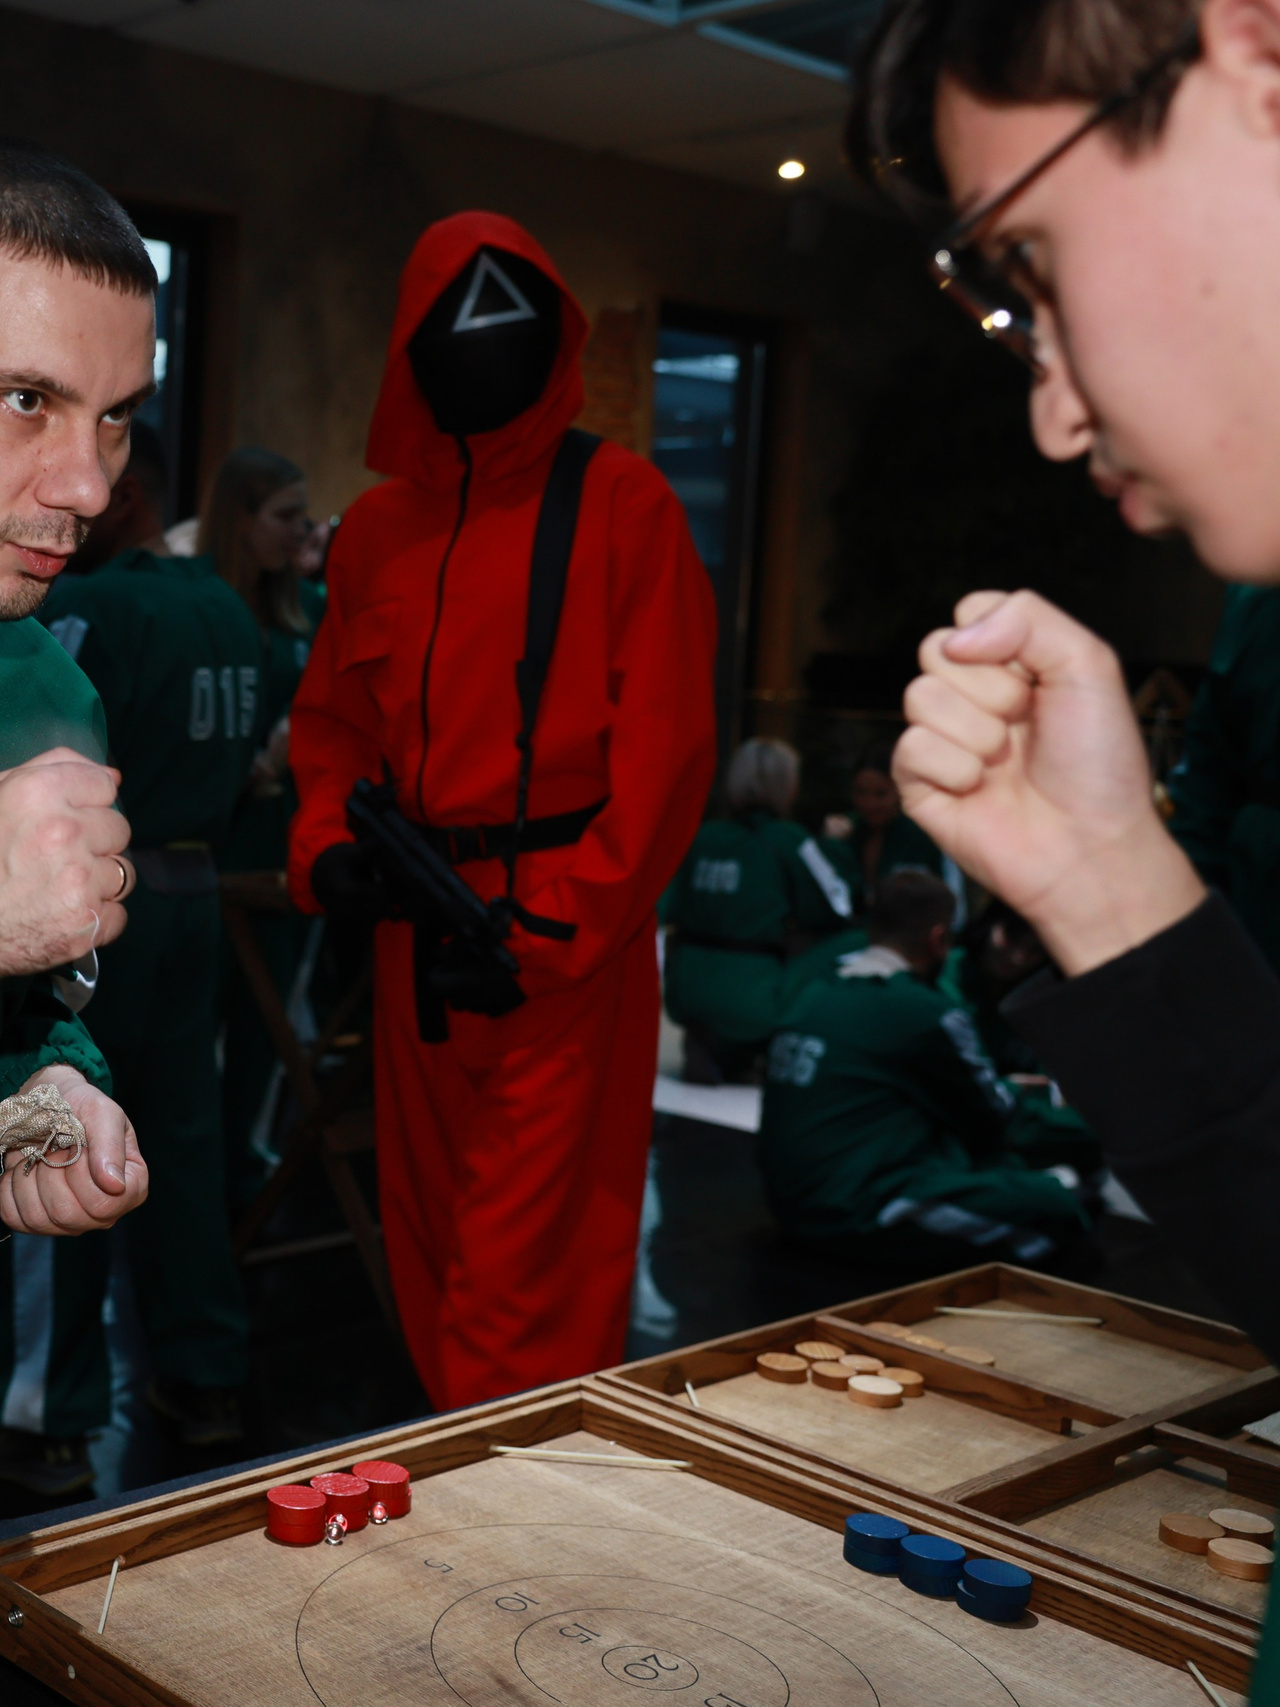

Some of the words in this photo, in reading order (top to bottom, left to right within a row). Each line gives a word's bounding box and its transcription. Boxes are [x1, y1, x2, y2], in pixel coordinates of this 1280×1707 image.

[187, 665, 258, 742] 015
[423, 1558, 454, 1573] 5
[495, 1591, 541, 1612] 10
[558, 1622, 602, 1644] 15
[623, 1653, 679, 1681] 20
